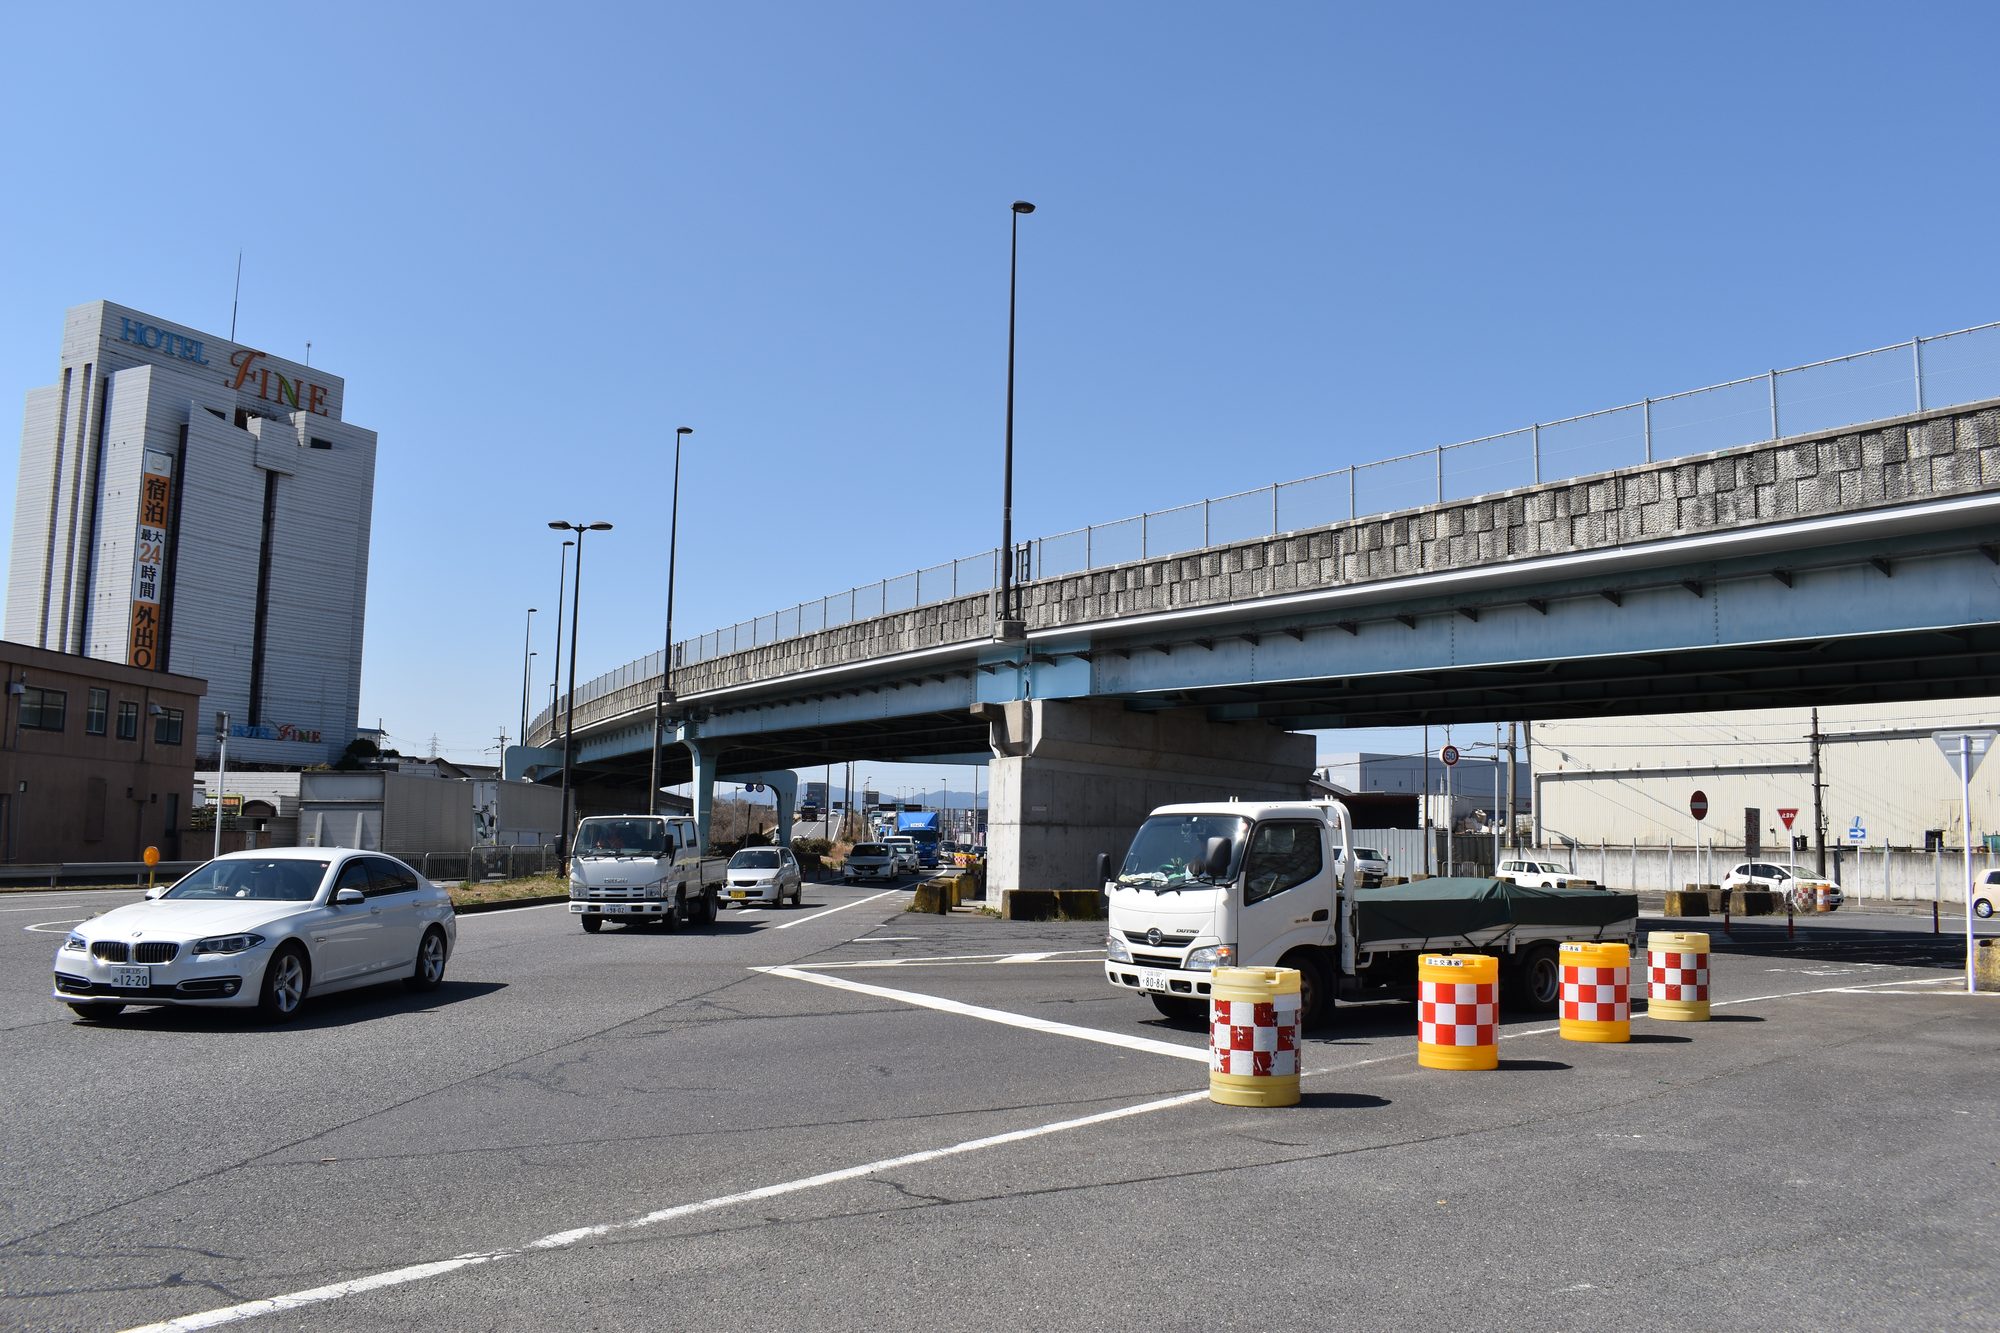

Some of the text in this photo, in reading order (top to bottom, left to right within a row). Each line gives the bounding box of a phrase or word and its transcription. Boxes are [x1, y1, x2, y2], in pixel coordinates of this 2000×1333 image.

[120, 316, 328, 416] HOTEL FINE
[144, 478, 167, 525] 宿泊
[1446, 751, 1456, 760] 50
[120, 975, 147, 986] 12-20
[1145, 977, 1164, 989] 80-86
